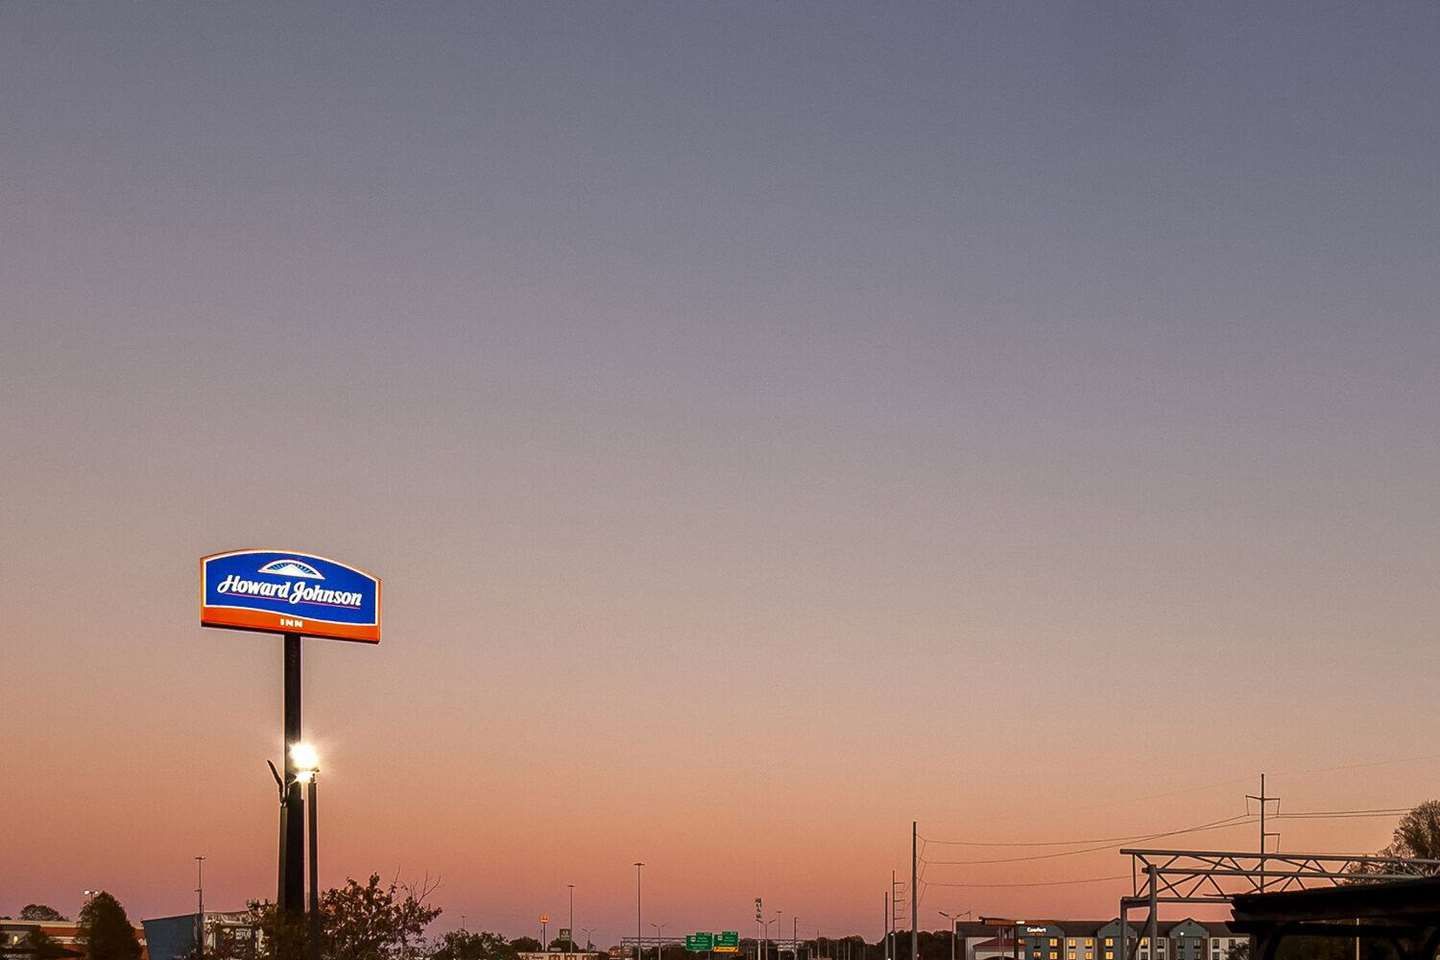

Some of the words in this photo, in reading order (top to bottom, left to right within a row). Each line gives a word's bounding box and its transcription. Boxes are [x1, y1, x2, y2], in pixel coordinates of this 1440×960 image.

[217, 575, 291, 598] Howard
[288, 581, 363, 606] Johnson
[280, 618, 303, 628] INN
